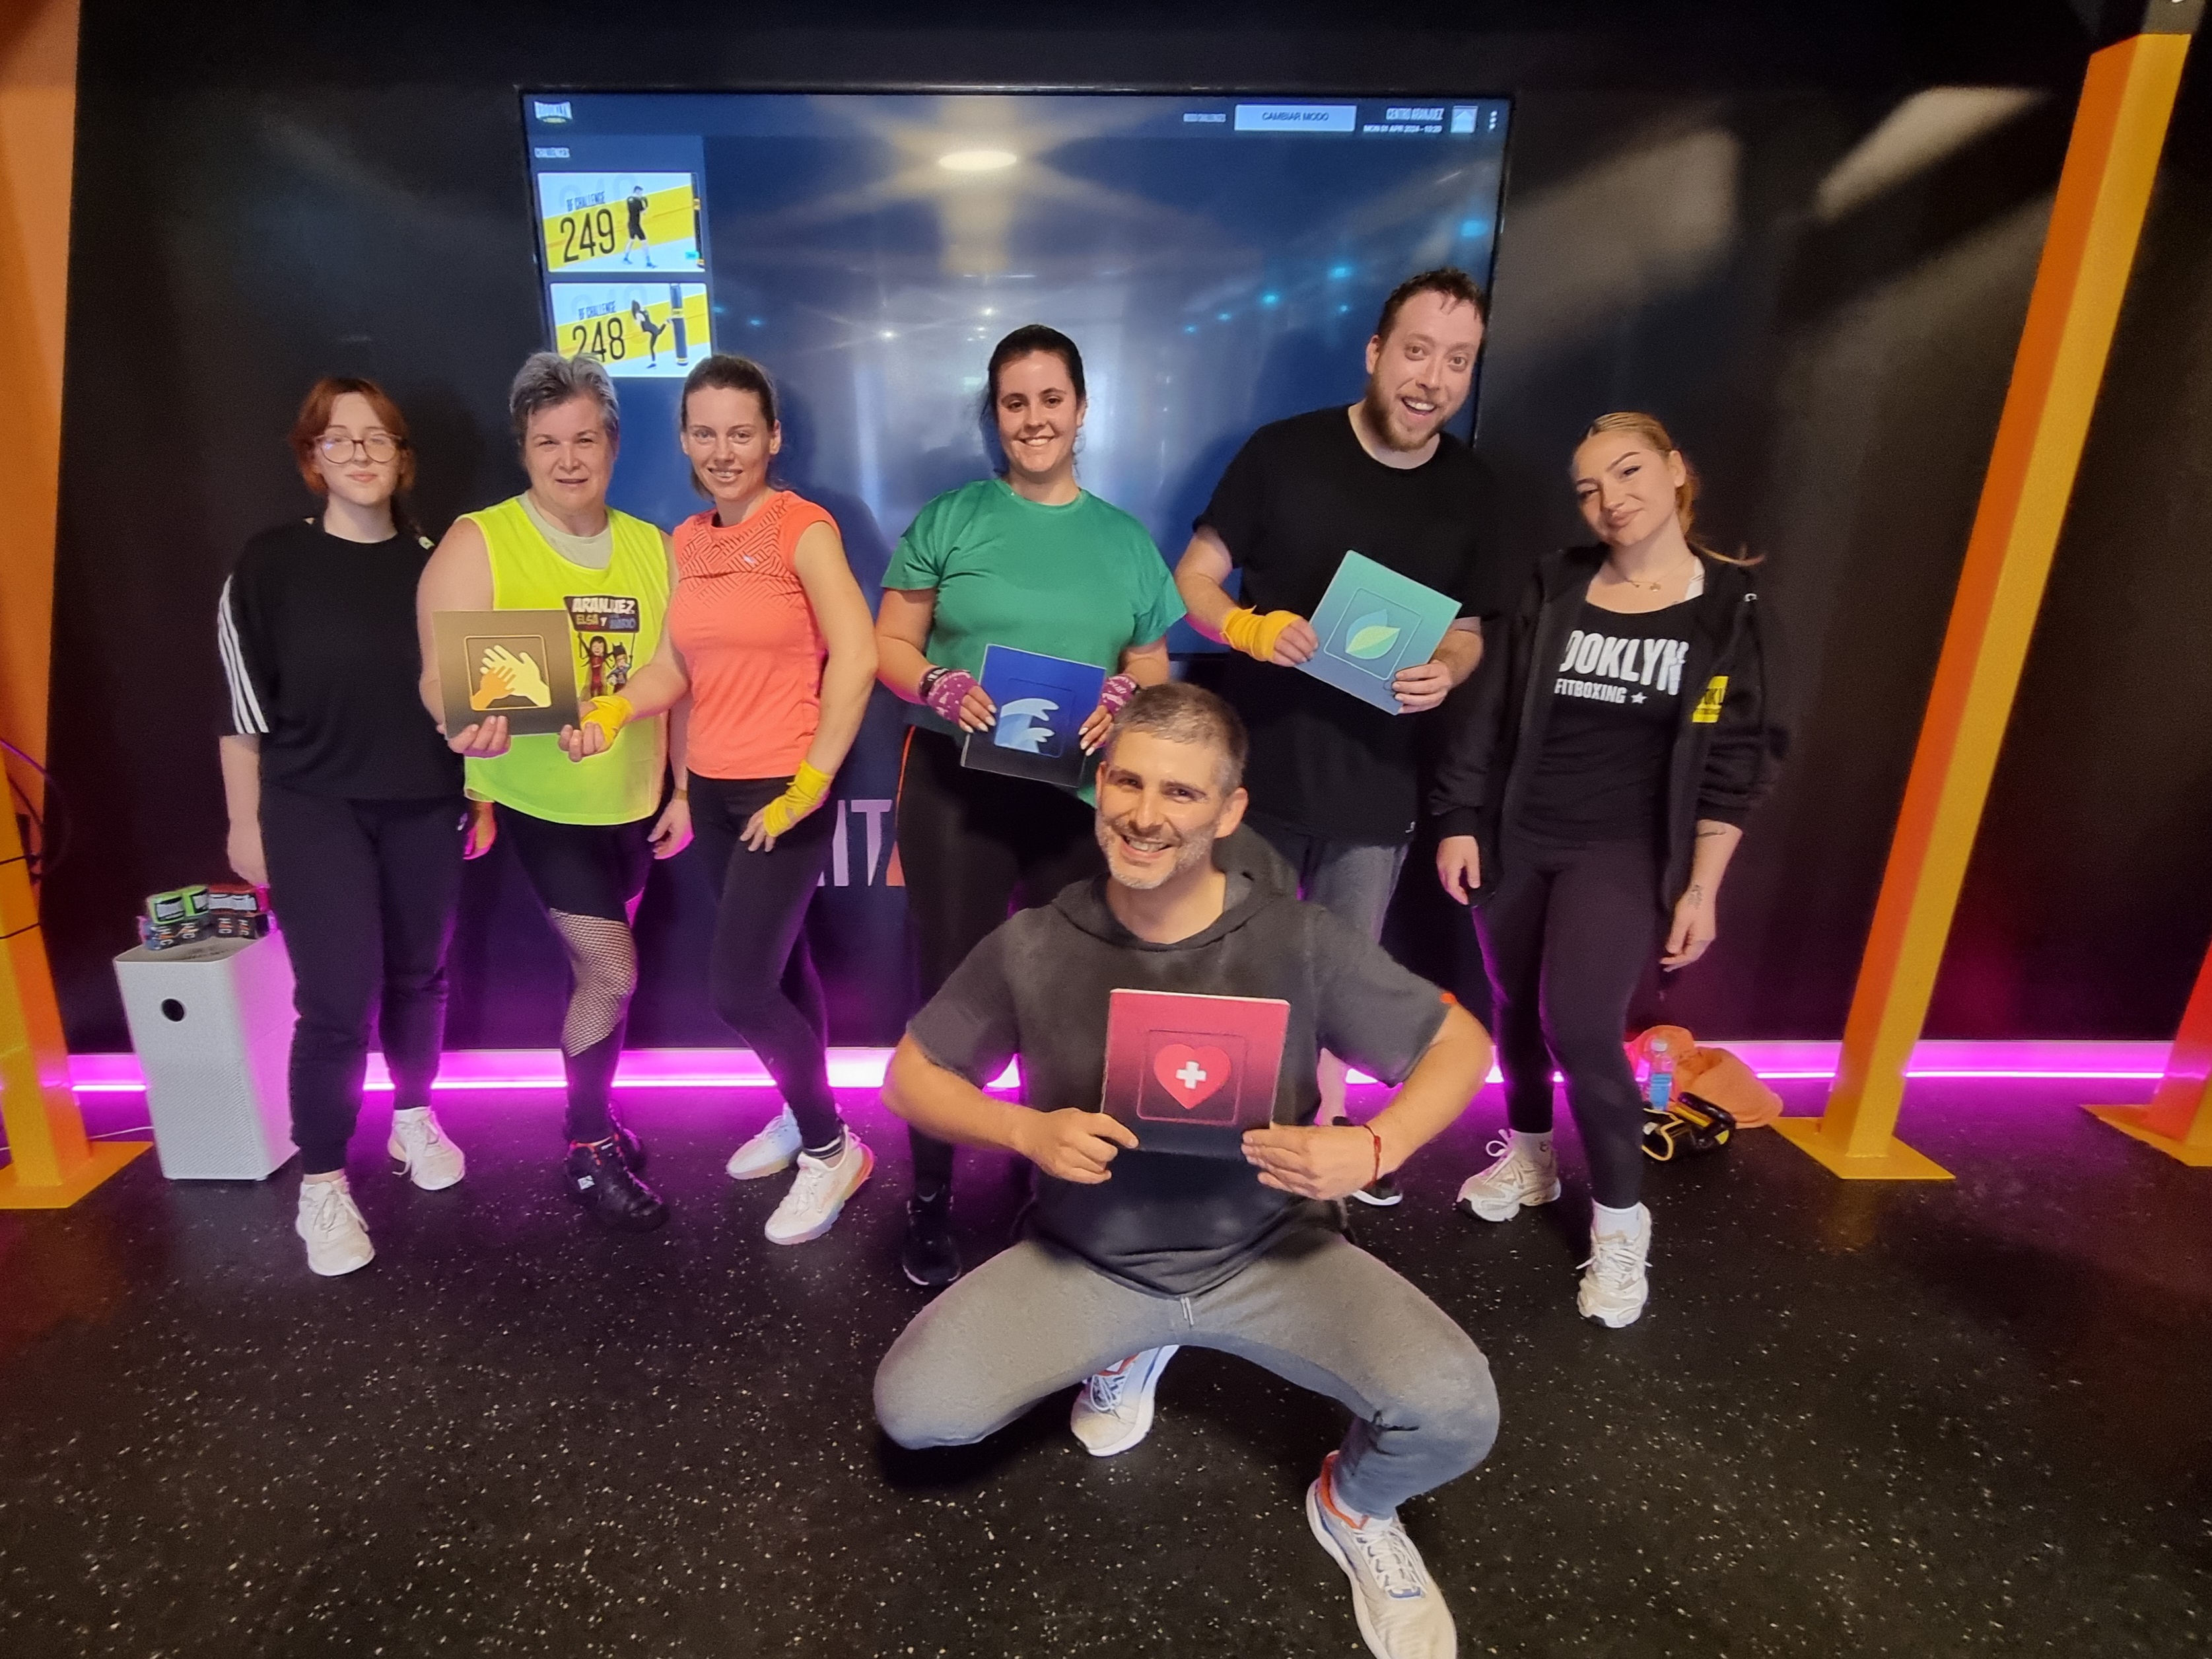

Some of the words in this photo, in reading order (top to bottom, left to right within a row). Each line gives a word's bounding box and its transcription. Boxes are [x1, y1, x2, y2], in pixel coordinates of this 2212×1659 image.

[1262, 112, 1301, 122] CAMBIAR
[1302, 112, 1329, 122] MODO
[560, 208, 615, 264] 249
[572, 317, 626, 363] 248
[572, 597, 636, 615] ARANJUEZ
[1554, 678, 1628, 704] FITBOXING
